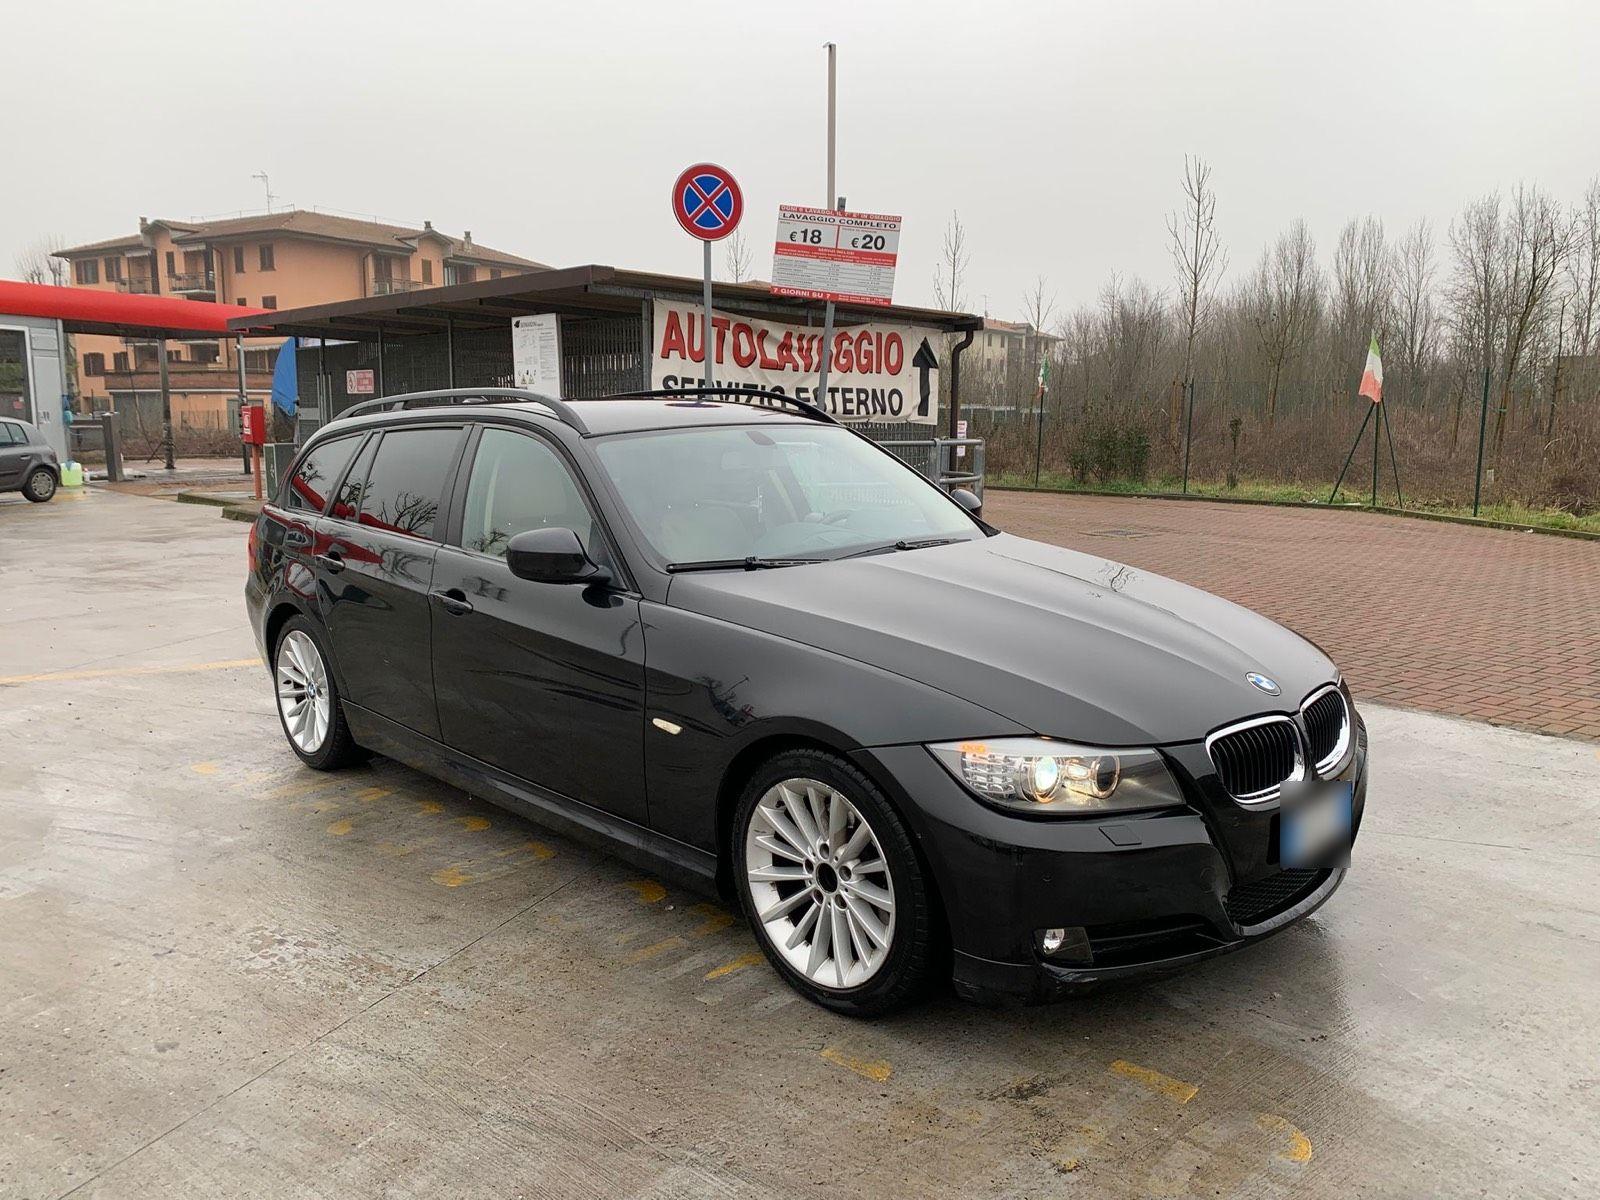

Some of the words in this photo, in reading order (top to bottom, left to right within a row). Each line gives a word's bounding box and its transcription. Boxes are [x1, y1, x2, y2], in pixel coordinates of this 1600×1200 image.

[782, 213, 836, 224] LAVAGGIO
[839, 218, 897, 230] COMPLETO
[780, 288, 810, 297] GIORNI
[811, 291, 824, 299] SU
[660, 310, 904, 377] AUTOLAVAGGIO
